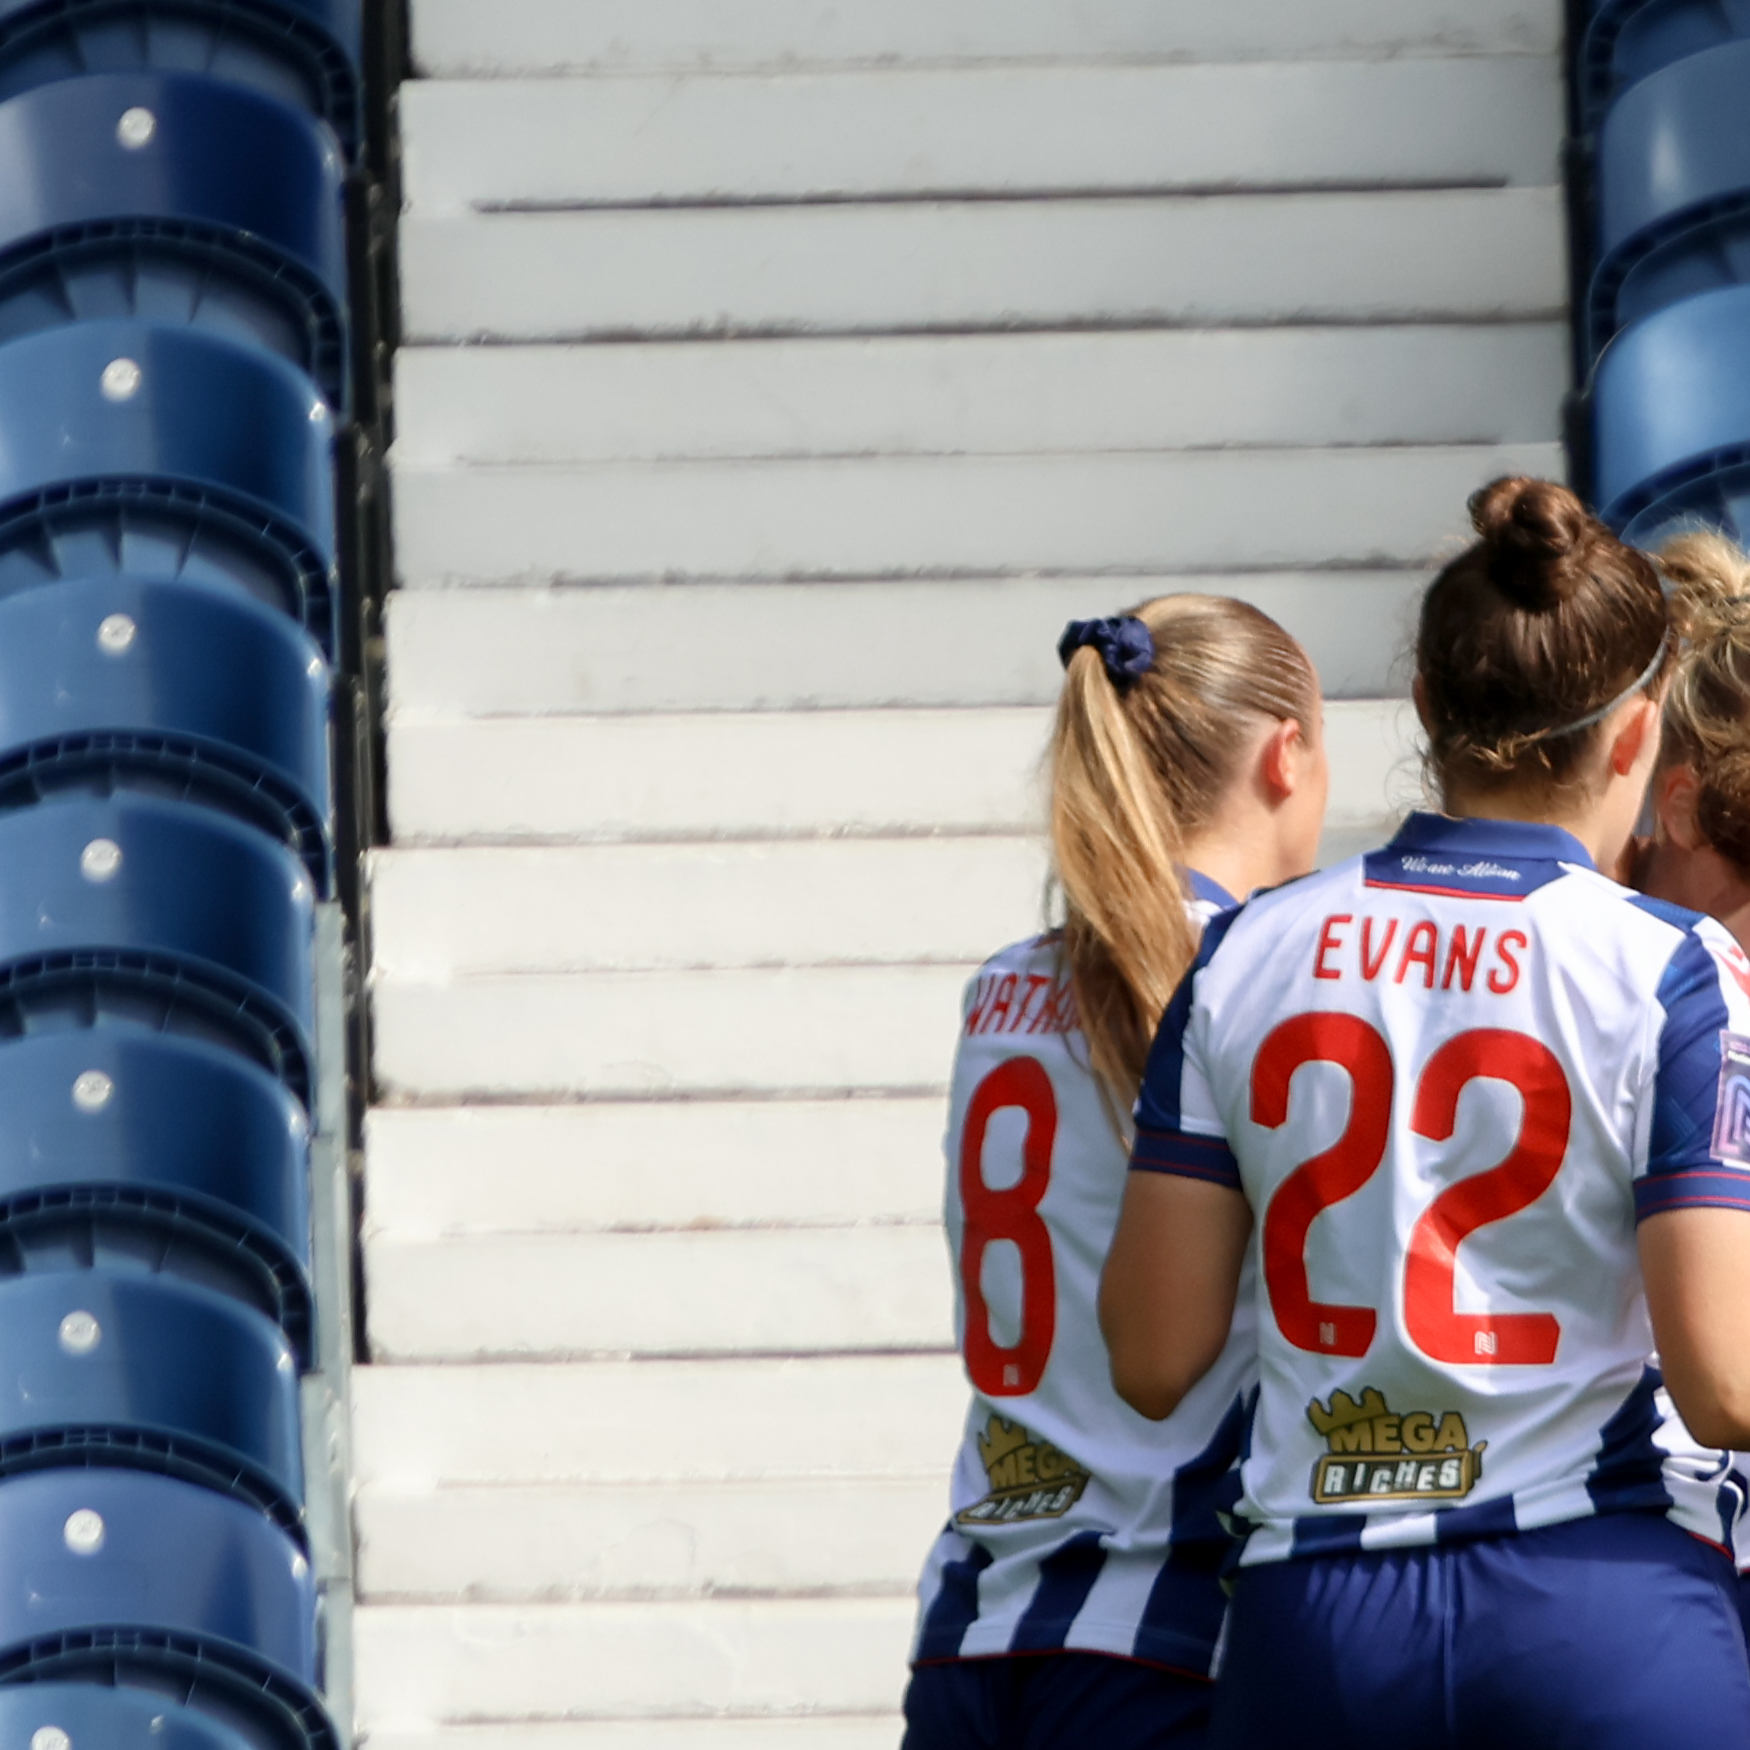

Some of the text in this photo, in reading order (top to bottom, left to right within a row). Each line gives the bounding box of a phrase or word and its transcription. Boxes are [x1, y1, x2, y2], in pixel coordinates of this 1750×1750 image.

[1312, 913, 1528, 995] EVANS
[959, 1055, 1057, 1397] 8
[1249, 1011, 1572, 1366] 22
[1330, 1411, 1469, 1454] MEGA
[1323, 1458, 1461, 1494] RICHES
